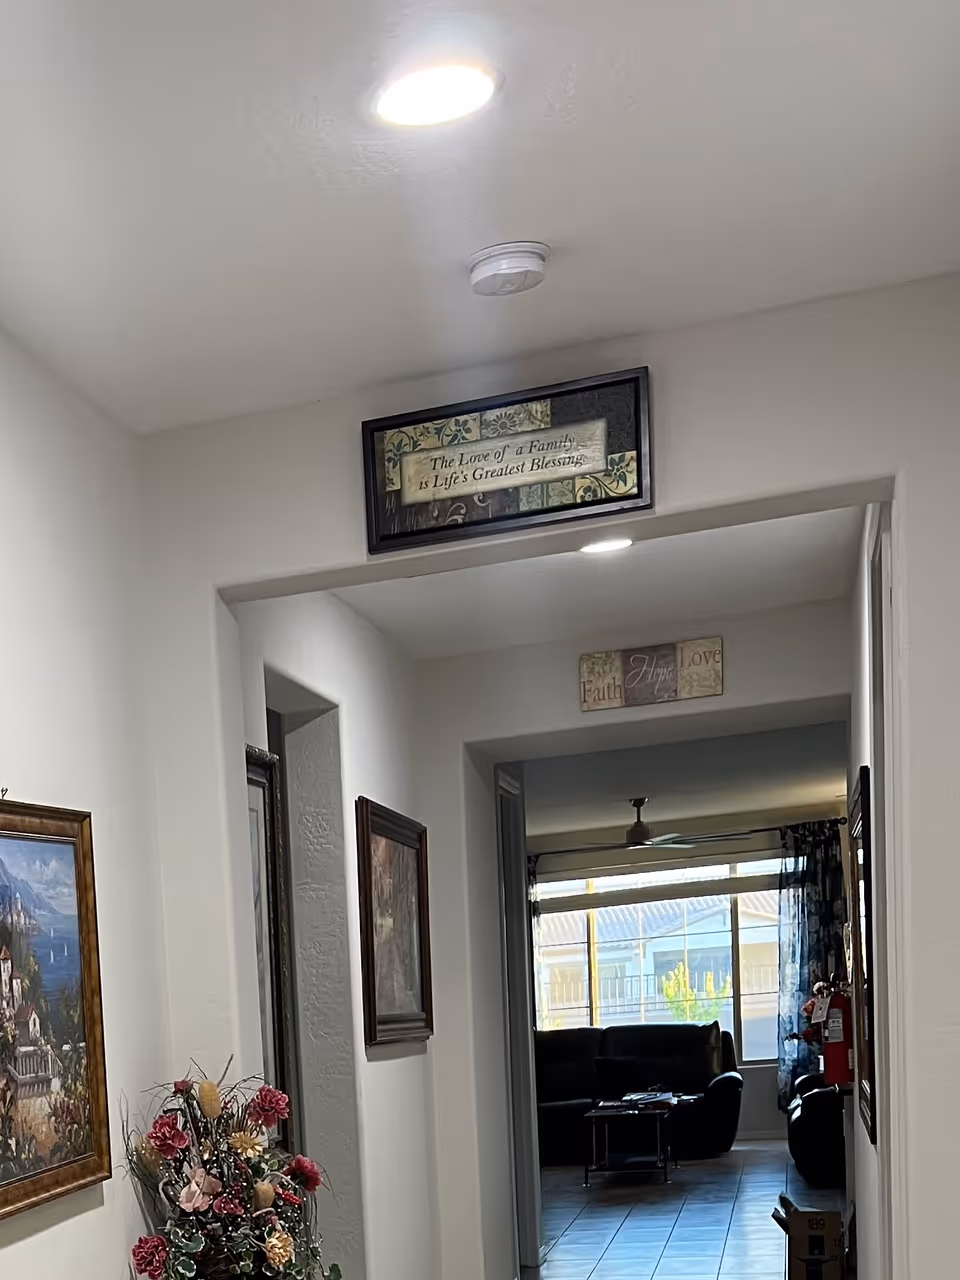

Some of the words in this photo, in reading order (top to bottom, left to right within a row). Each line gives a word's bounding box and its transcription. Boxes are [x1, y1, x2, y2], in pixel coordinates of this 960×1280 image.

[430, 455, 455, 470] The
[458, 452, 490, 467] Love
[494, 444, 510, 464] of
[515, 446, 524, 456] a
[528, 433, 575, 454] Family
[419, 475, 430, 490] is
[432, 470, 468, 490] Life's
[472, 460, 526, 481] Greatest
[680, 646, 721, 668] Love
[625, 654, 673, 694] Hope
[581, 677, 622, 703] Faith
